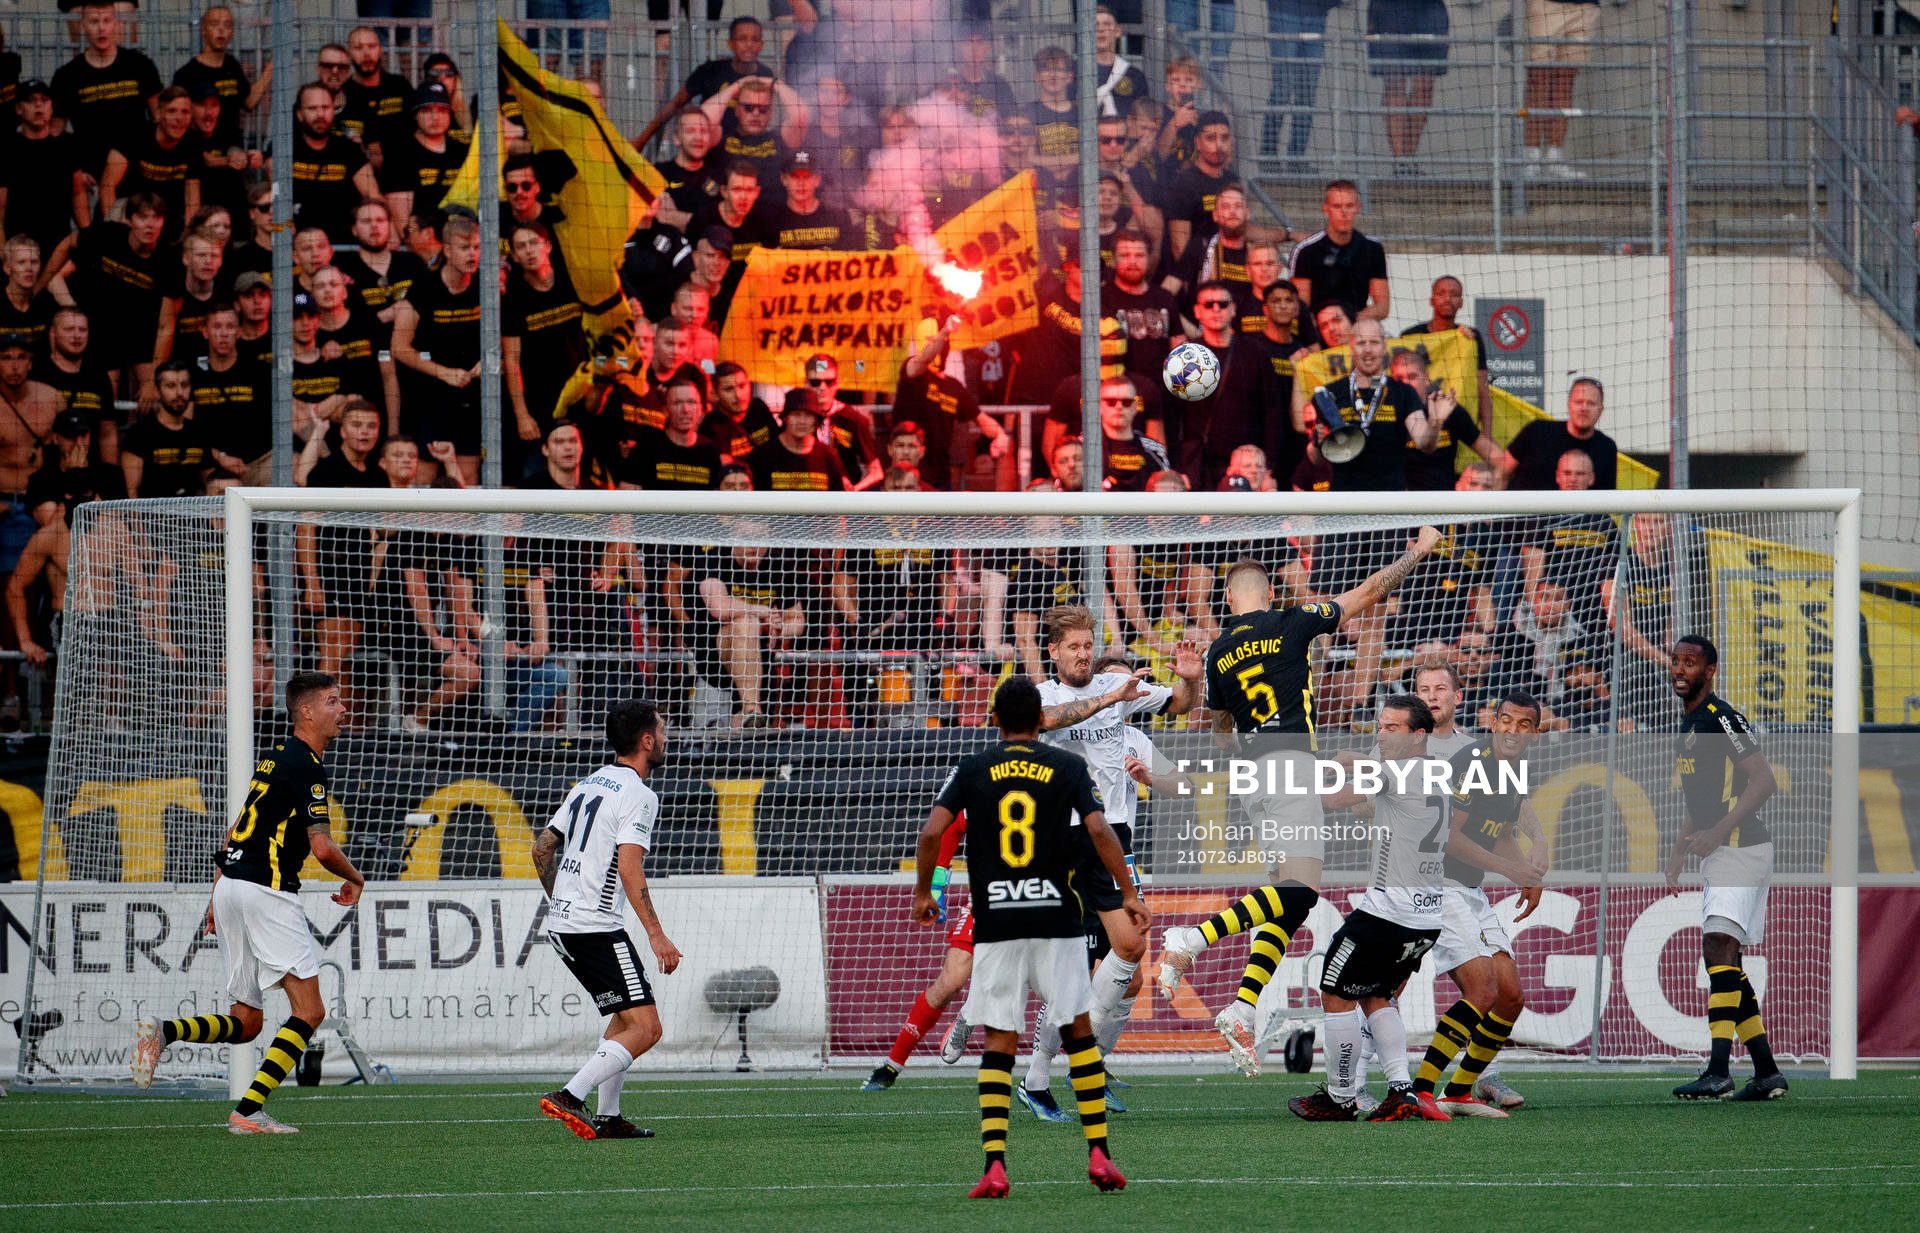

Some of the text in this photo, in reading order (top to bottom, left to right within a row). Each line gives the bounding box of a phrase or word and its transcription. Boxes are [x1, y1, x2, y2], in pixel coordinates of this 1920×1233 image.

[782, 254, 898, 285] SKROTA
[761, 289, 912, 319] VILLKORS-
[759, 322, 904, 351] TRAPPAN!
[1217, 636, 1283, 674] MILOŠEVIĆ
[1236, 663, 1279, 724] 5
[990, 760, 1054, 783] HUSSEIN
[568, 793, 604, 853] 11
[998, 790, 1037, 868] 8
[987, 878, 1062, 901] SVEA
[1337, 1042, 1353, 1088] BRÖDERNAS
